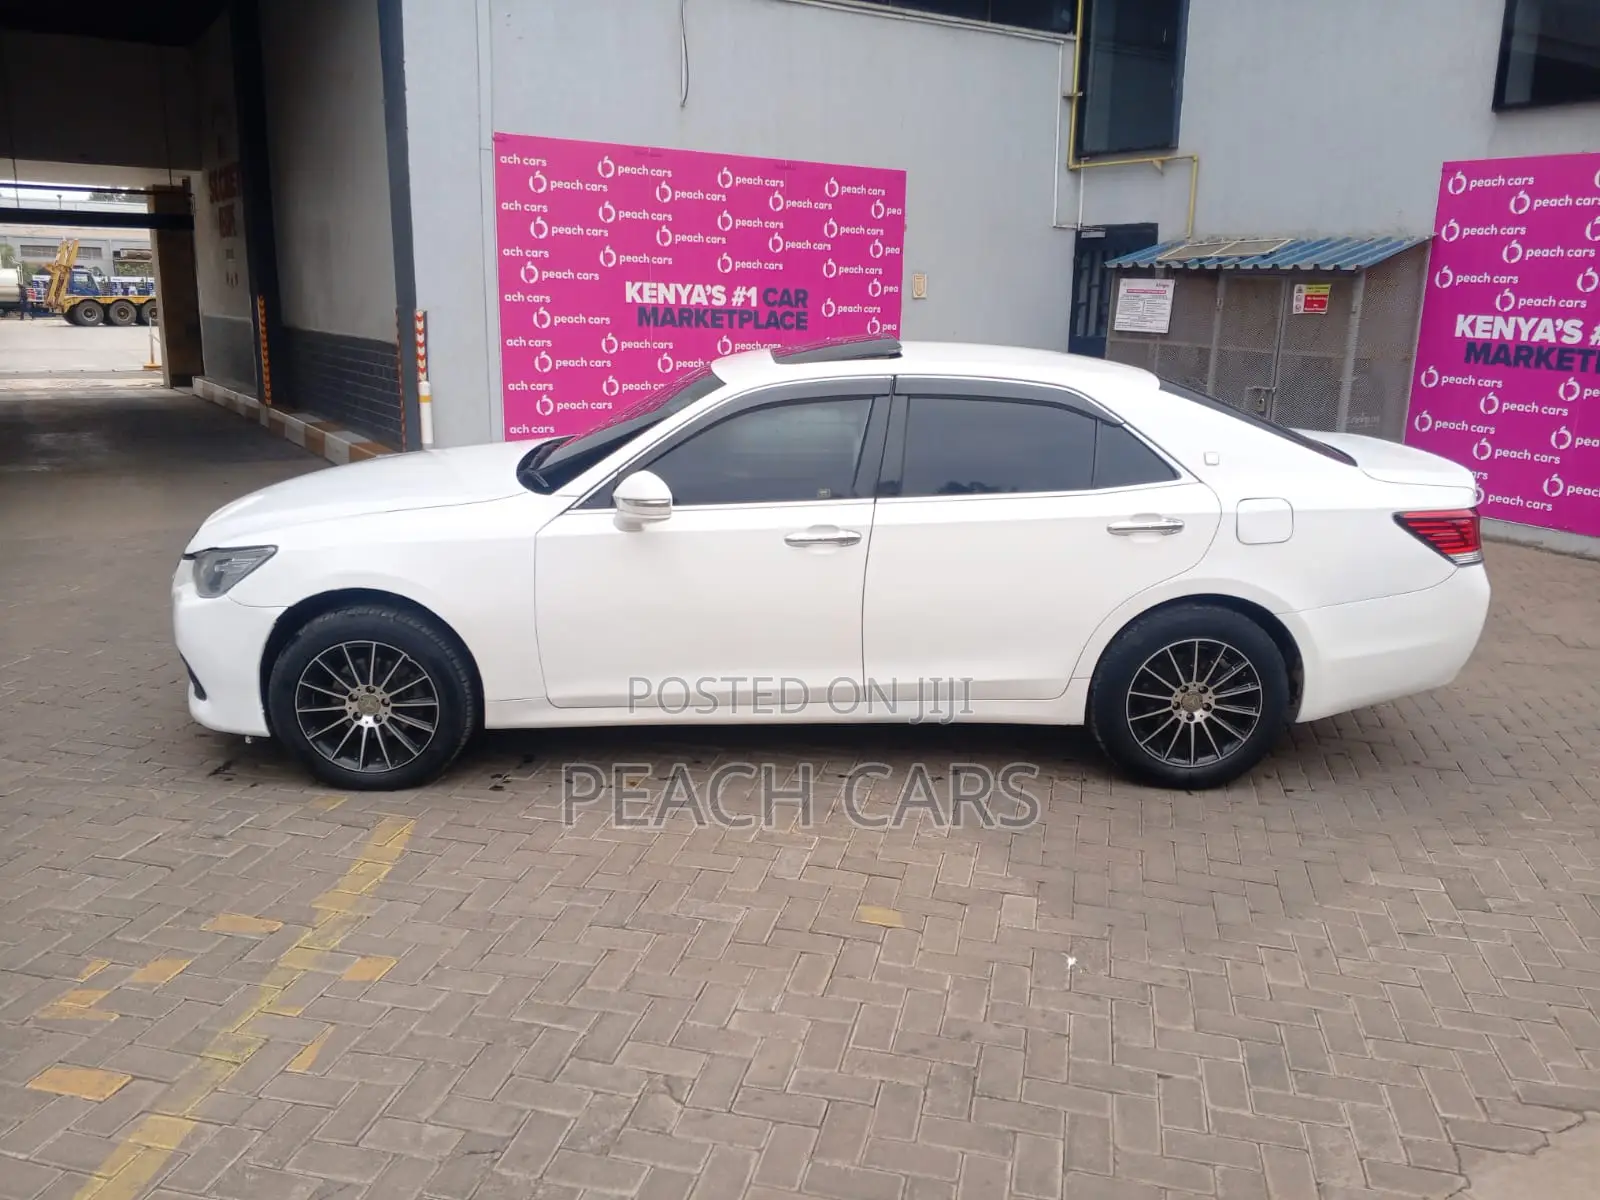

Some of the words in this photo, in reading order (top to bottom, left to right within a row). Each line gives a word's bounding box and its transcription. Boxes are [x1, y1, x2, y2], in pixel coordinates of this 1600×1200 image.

[500, 154, 520, 164] ach
[523, 158, 546, 166] cars
[618, 165, 648, 176] peach
[650, 169, 672, 177] cars
[551, 180, 583, 190] peach
[585, 184, 608, 192] cars
[736, 176, 763, 186] peach
[765, 179, 784, 187] cars
[1470, 176, 1505, 190] peach
[1508, 177, 1534, 185] cars
[675, 190, 704, 200] peach
[706, 193, 726, 201] cars
[841, 185, 866, 195] peach
[867, 188, 885, 196] cars
[502, 200, 521, 210] ach
[524, 204, 548, 212] cars
[786, 199, 812, 208] peach
[1534, 195, 1572, 210] peach
[619, 210, 649, 220] peach
[651, 213, 672, 221] cars
[736, 218, 762, 229] peach
[552, 225, 584, 236] peach
[586, 228, 608, 236] cars
[840, 225, 865, 235] peach
[1463, 224, 1497, 238] peach
[1500, 227, 1526, 235] cars
[675, 233, 704, 244] peach
[706, 236, 726, 244] cars
[503, 246, 523, 256] ach
[786, 240, 811, 250] peach
[620, 254, 650, 264] peach
[1526, 246, 1564, 260] peach
[1567, 249, 1595, 257] cars
[735, 260, 762, 271] peach
[839, 265, 863, 275] peach
[542, 269, 574, 281] peach
[1456, 272, 1491, 285] peach
[505, 292, 524, 301] ach
[527, 295, 550, 303] cars
[732, 287, 757, 307] #1
[763, 288, 809, 309] CAR
[1518, 296, 1556, 309] peach
[1558, 300, 1586, 308] cars
[838, 304, 862, 314] peach
[554, 314, 586, 326] peach
[637, 306, 808, 330] MARKETPLACE
[506, 337, 526, 346] ach
[621, 340, 650, 351] peach
[735, 342, 762, 353] peach
[556, 357, 587, 369] peach
[676, 359, 706, 371] peach
[508, 381, 528, 390] ach
[622, 381, 651, 393] peach
[1441, 375, 1475, 386] peach
[1478, 379, 1502, 388] cars
[557, 400, 588, 412] peach
[1502, 402, 1539, 413] peach
[1541, 407, 1568, 416] cars
[510, 424, 529, 433] ach
[1435, 421, 1468, 431] peach
[1471, 425, 1495, 434] cars
[1495, 449, 1531, 460] peach
[1534, 454, 1560, 464] cars
[1567, 485, 1600, 497] peac
[1488, 494, 1523, 506] peach
[1526, 501, 1552, 511] cars
